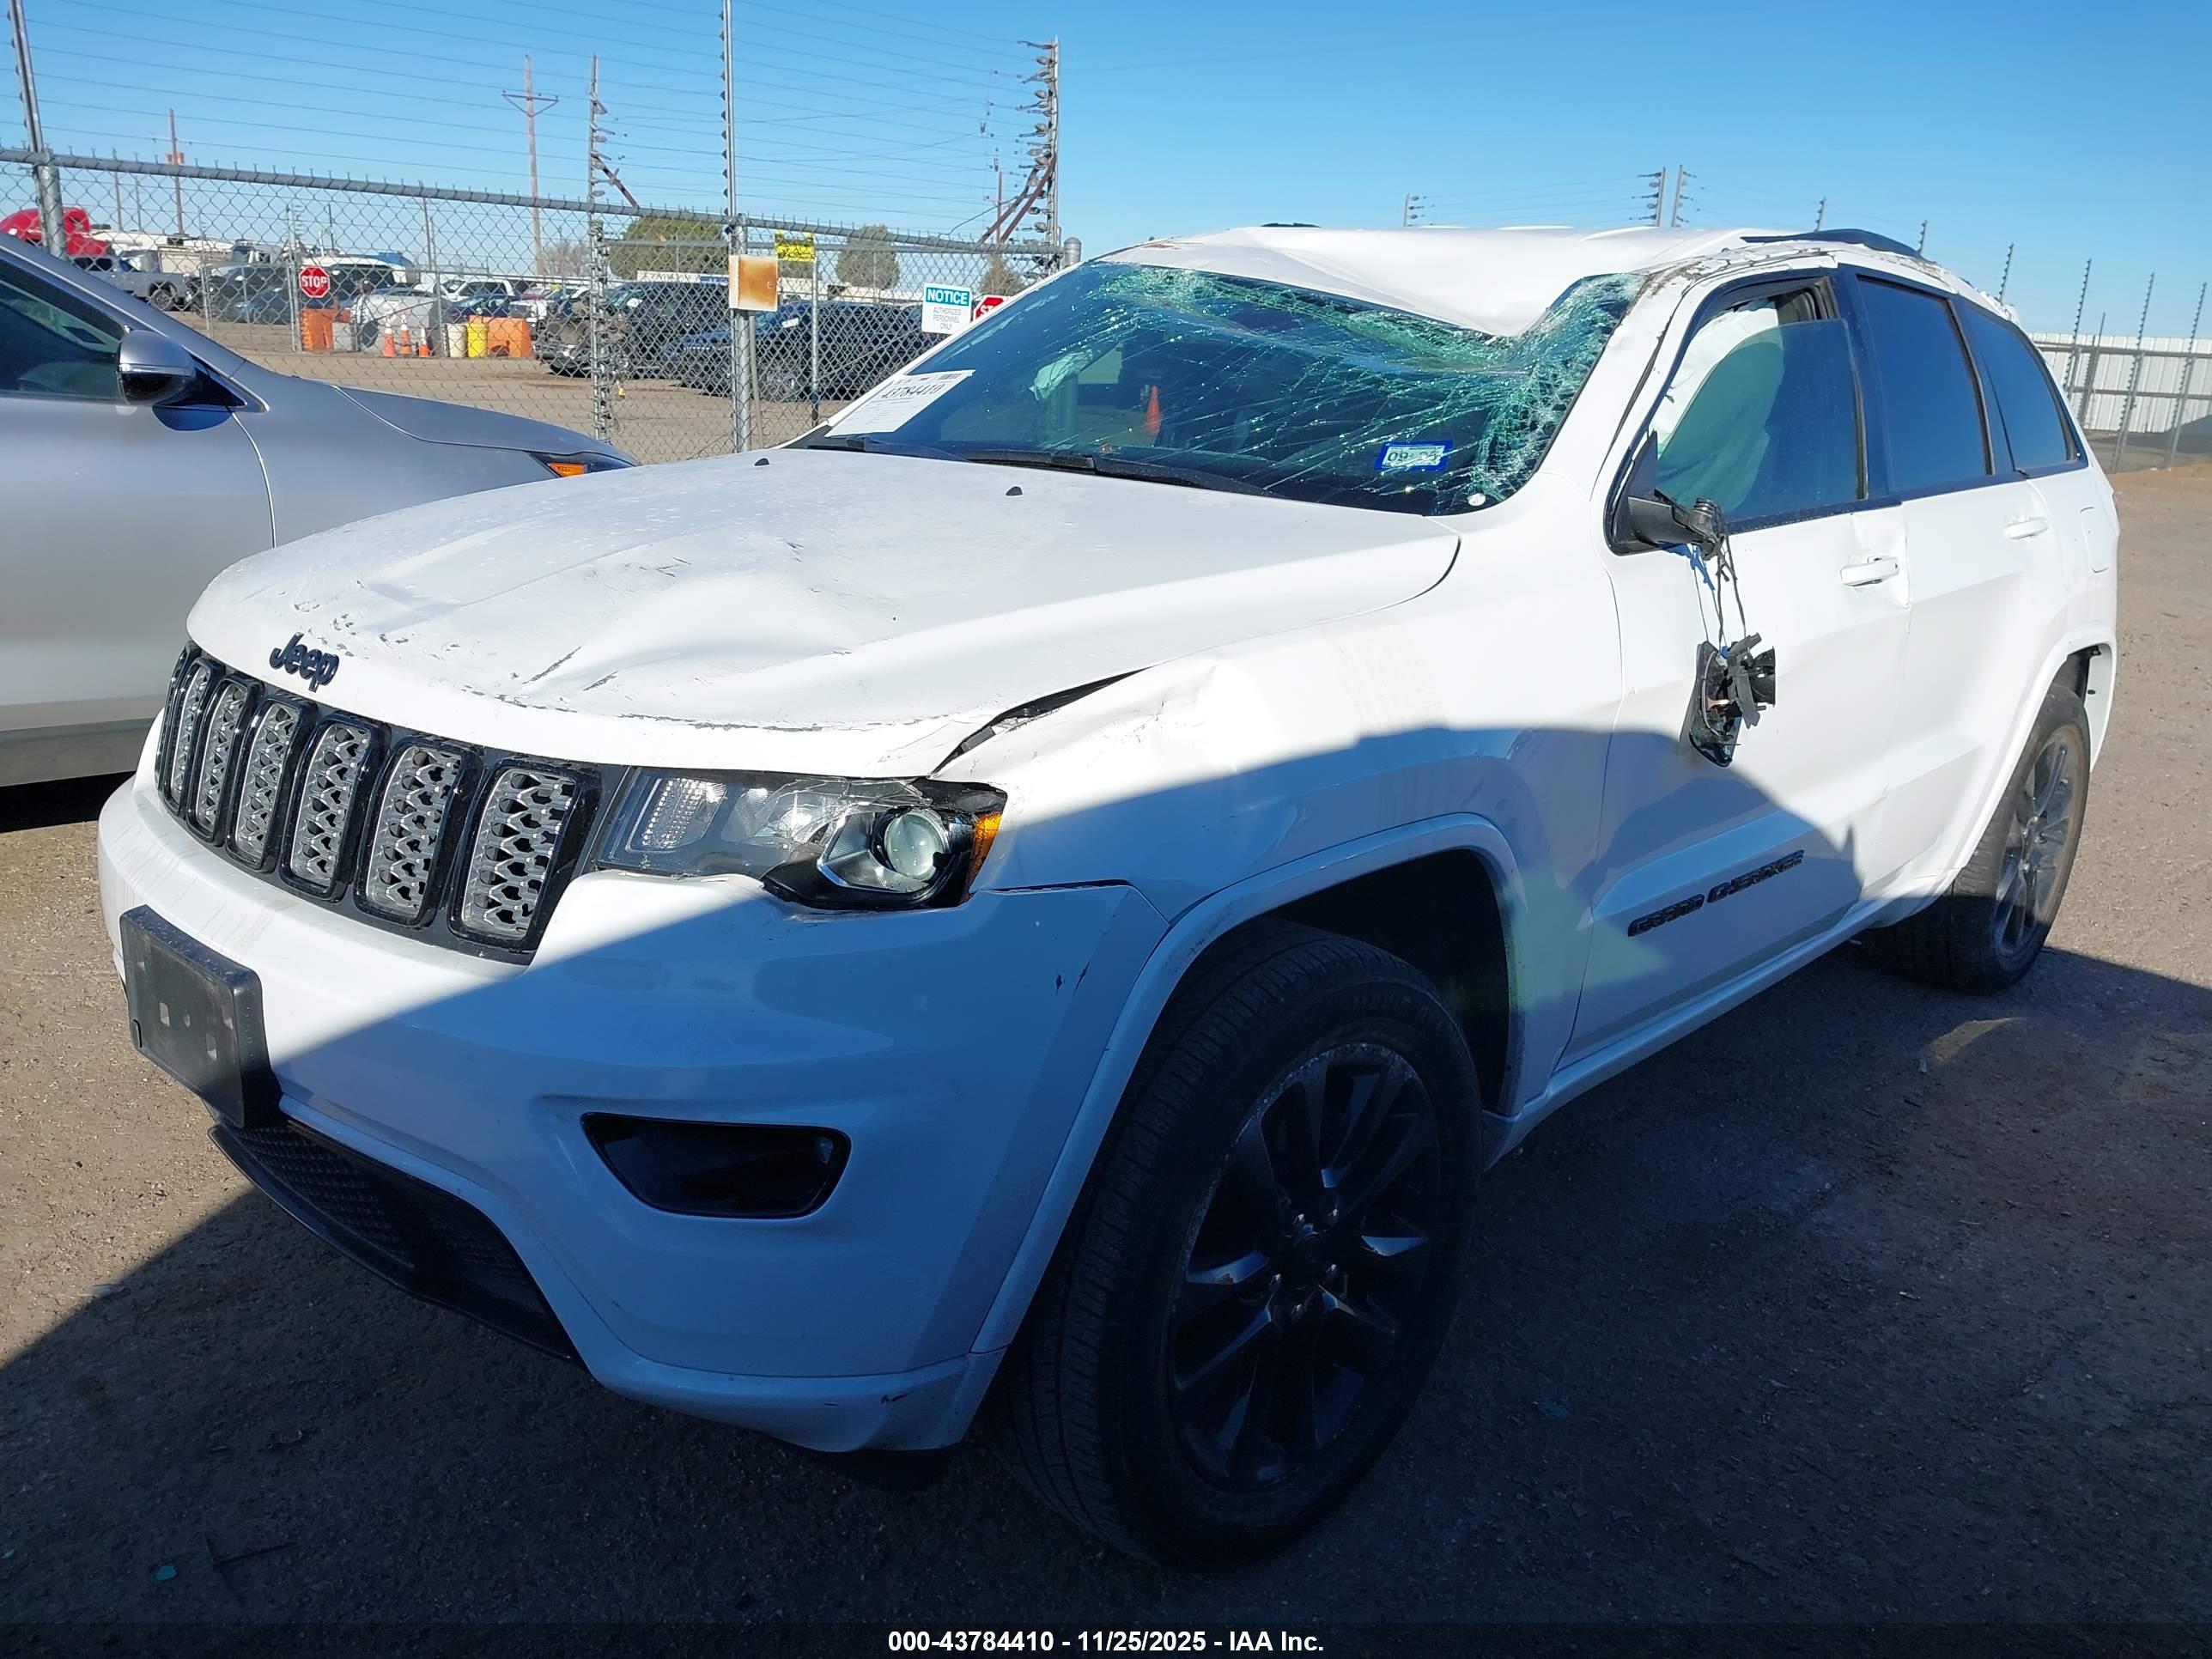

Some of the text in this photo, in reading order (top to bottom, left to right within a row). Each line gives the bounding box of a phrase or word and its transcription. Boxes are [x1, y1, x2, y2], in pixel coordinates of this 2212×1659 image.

[301, 275, 327, 288] STOP
[927, 288, 968, 305] NOTICE
[269, 631, 339, 693] Jeep
[1627, 849, 1805, 937] GRAND CHEROKEE
